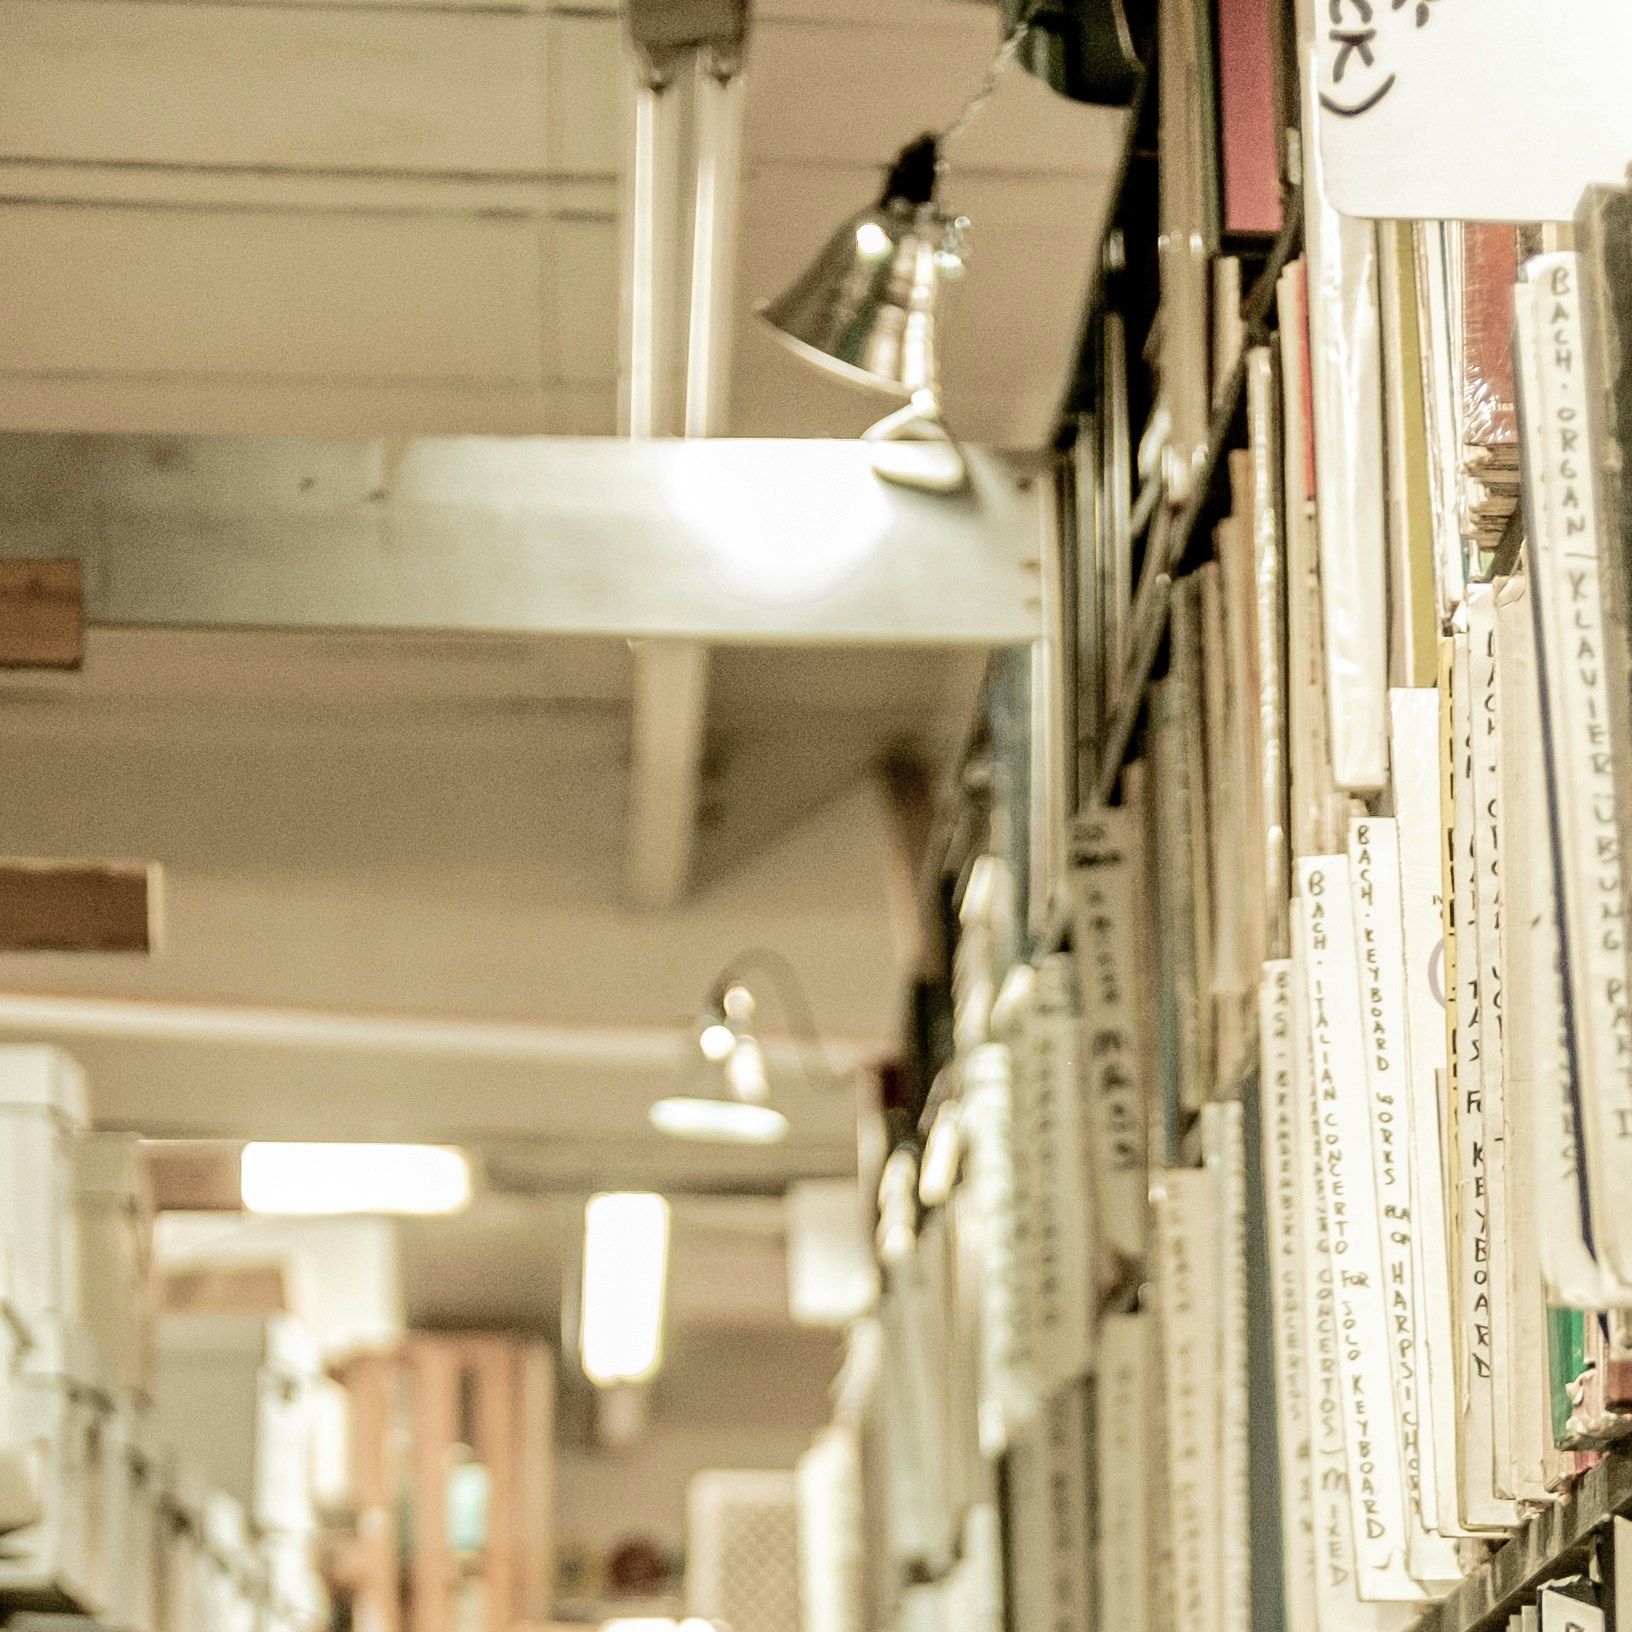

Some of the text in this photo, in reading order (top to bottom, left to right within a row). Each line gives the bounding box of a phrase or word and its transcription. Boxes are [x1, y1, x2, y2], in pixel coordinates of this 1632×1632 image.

[1549, 264, 1588, 538] BACH ORGAN
[1307, 869, 1328, 951] BACH
[1354, 823, 1374, 906] BACH
[1312, 979, 1338, 1102] ITALIAN
[1362, 926, 1390, 1073] KEYBOARD
[1323, 1111, 1350, 1256] CONCERTO
[1375, 1091, 1398, 1186] WORKS
[1340, 1268, 1373, 1289] FOR
[1340, 1299, 1363, 1362] SOLO
[1350, 1373, 1387, 1541] KEYBOARD
[1321, 1468, 1350, 1588] MIXED
